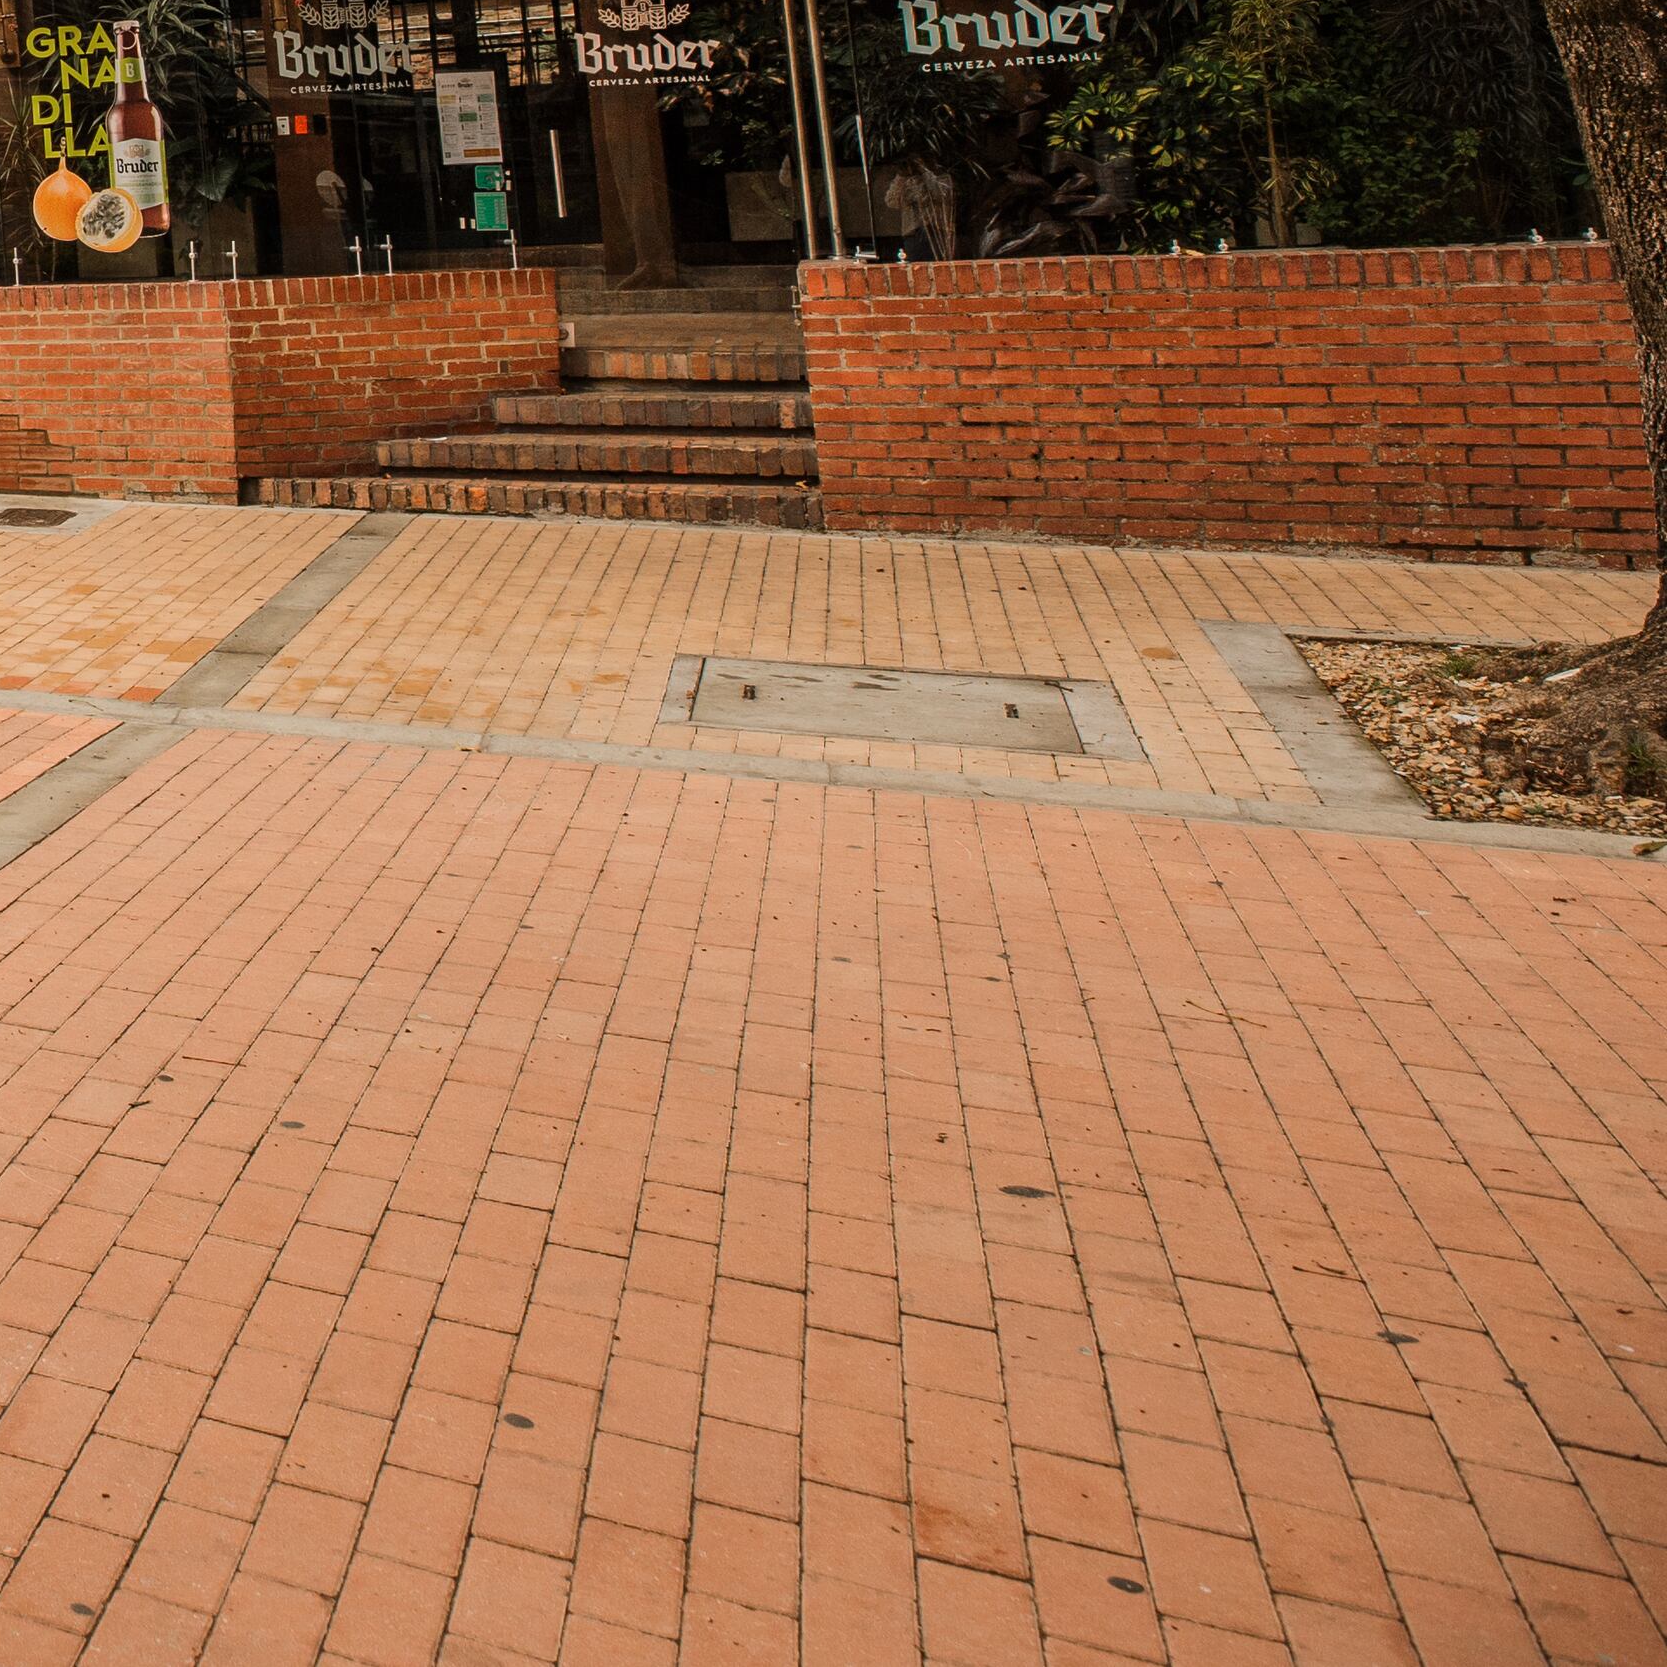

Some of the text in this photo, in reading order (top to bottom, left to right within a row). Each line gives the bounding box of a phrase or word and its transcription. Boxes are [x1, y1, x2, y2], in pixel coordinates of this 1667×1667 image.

[26, 22, 116, 58] GRA
[273, 30, 415, 79] Bruder
[573, 32, 720, 74] Bruder
[60, 55, 116, 90] NA
[125, 62, 135, 77] B
[922, 52, 1102, 72] CERVEZA ARTESANAL
[290, 80, 411, 94] CERVEZA ARTESANAL
[589, 75, 711, 87] CERVEZA ARTESANAL
[31, 93, 72, 125] DI
[43, 125, 112, 159] LLA
[116, 158, 158, 173] Bruder
